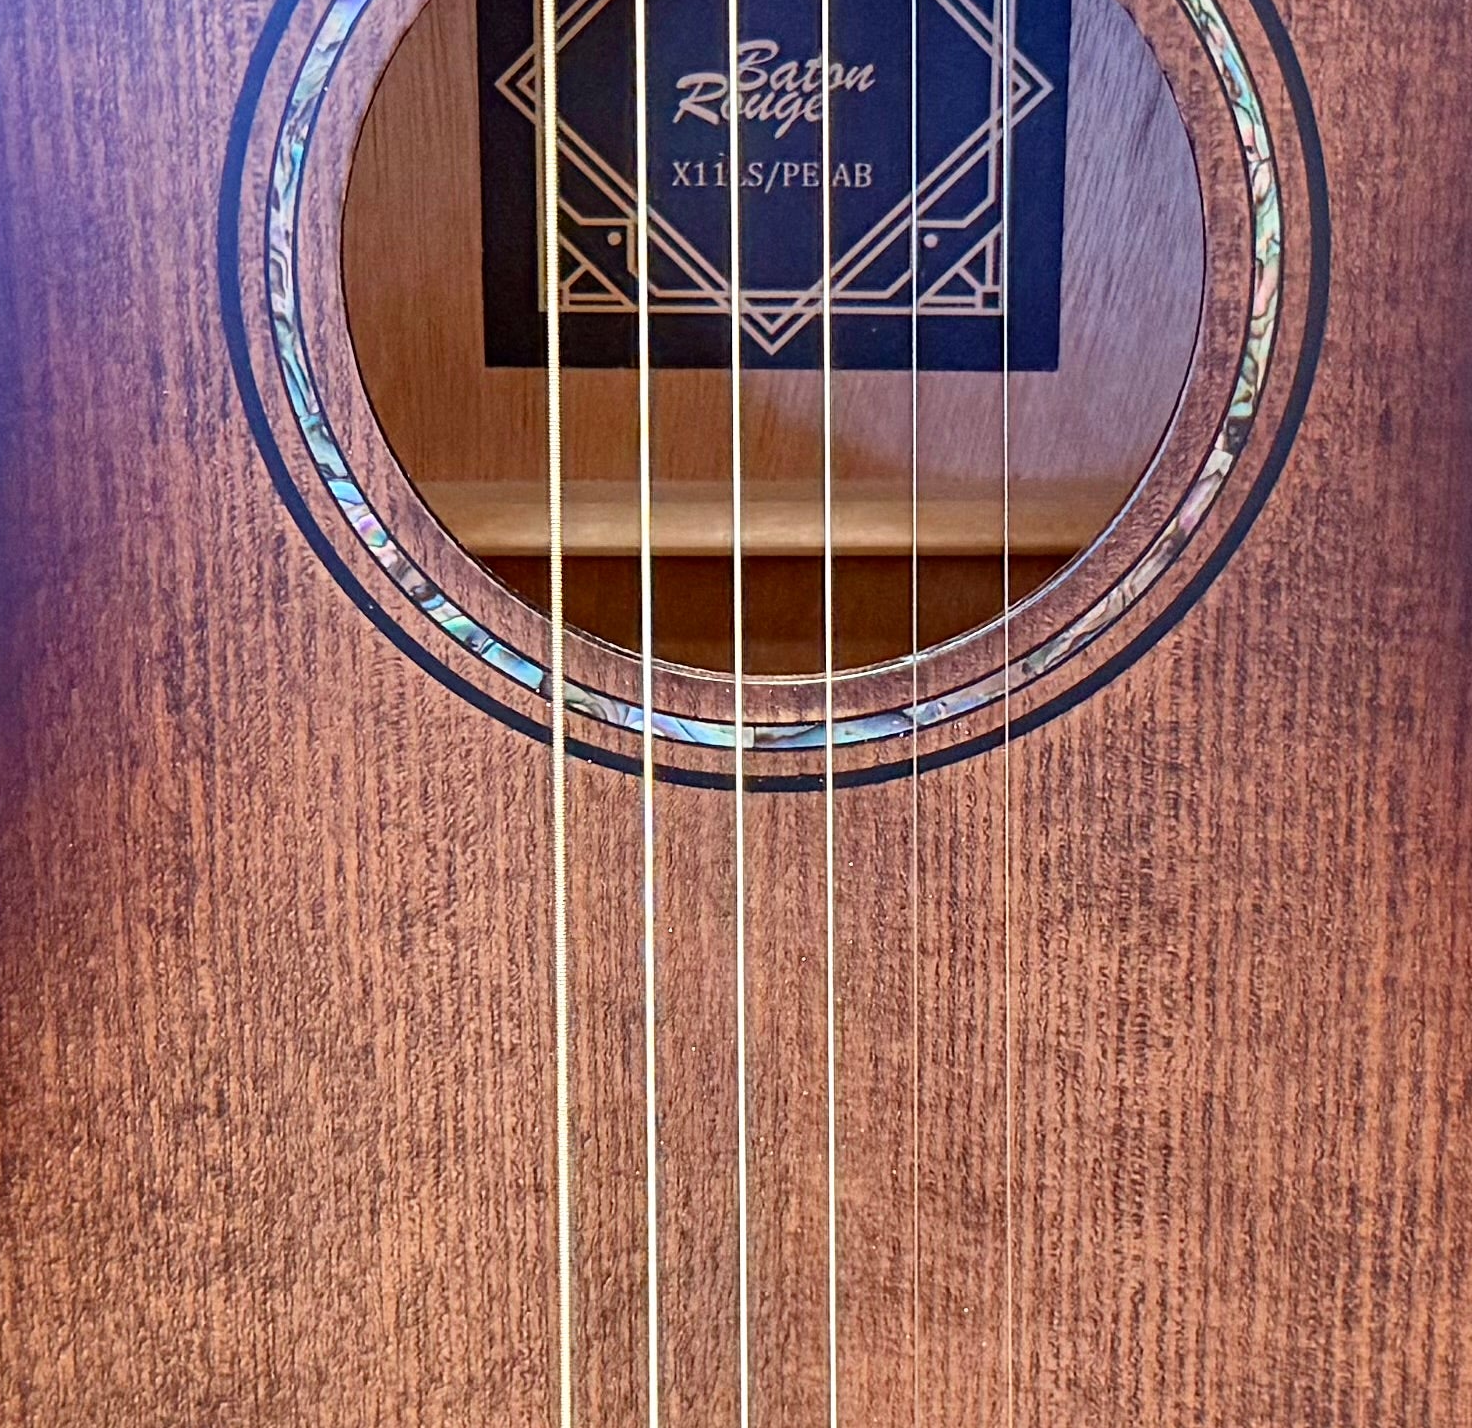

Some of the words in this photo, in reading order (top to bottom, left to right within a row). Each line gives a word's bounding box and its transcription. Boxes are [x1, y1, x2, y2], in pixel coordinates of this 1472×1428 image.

[735, 39, 876, 92] Baton
[672, 72, 824, 139] Rouge
[672, 161, 873, 193] X11S/PEAB
